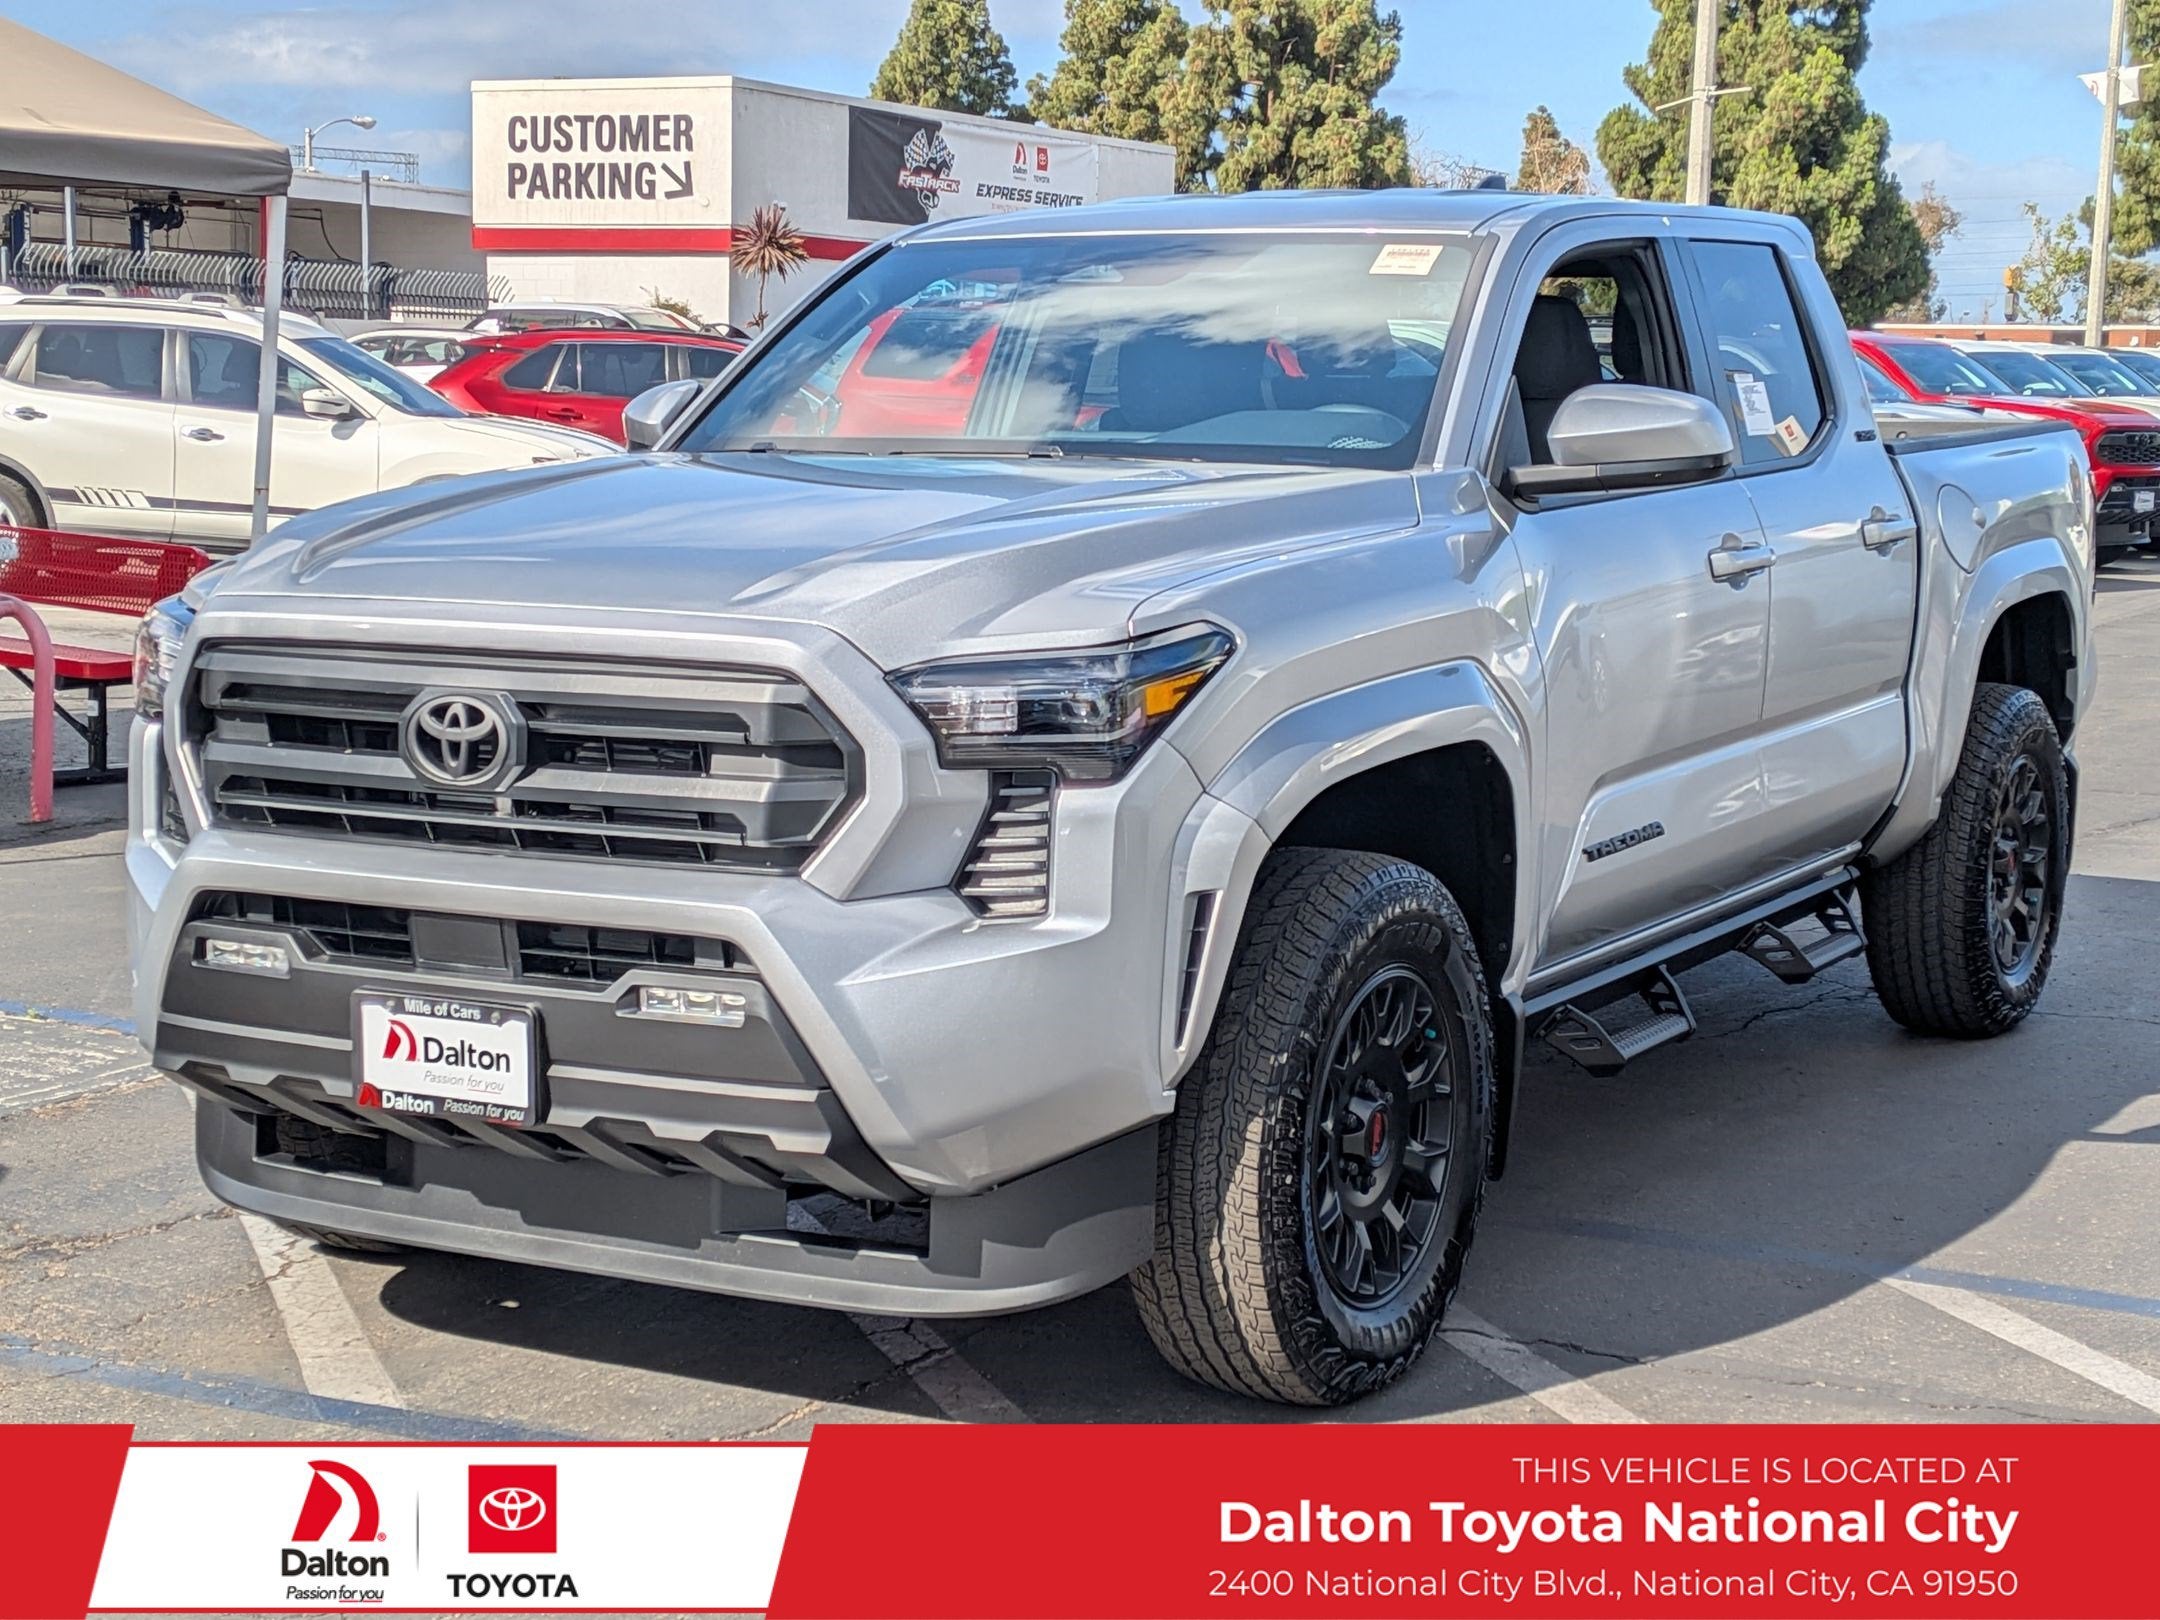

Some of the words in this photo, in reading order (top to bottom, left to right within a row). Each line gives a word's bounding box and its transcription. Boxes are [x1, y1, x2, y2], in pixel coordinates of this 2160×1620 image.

[508, 114, 694, 153] CUSTOMER
[507, 162, 657, 200] PARKING
[976, 183, 1033, 203] EXPRESS
[1582, 821, 1665, 862] TACOMA
[404, 998, 431, 1015] Mile
[434, 1002, 449, 1017] of
[450, 1004, 481, 1020] Cars
[423, 1036, 511, 1073] Dalton
[424, 1070, 464, 1086] Passion
[467, 1074, 483, 1089] for
[484, 1081, 505, 1092] you
[382, 1090, 435, 1114] Dalton
[443, 1099, 485, 1117] Passion
[485, 1103, 503, 1119] for
[502, 1109, 525, 1122] you
